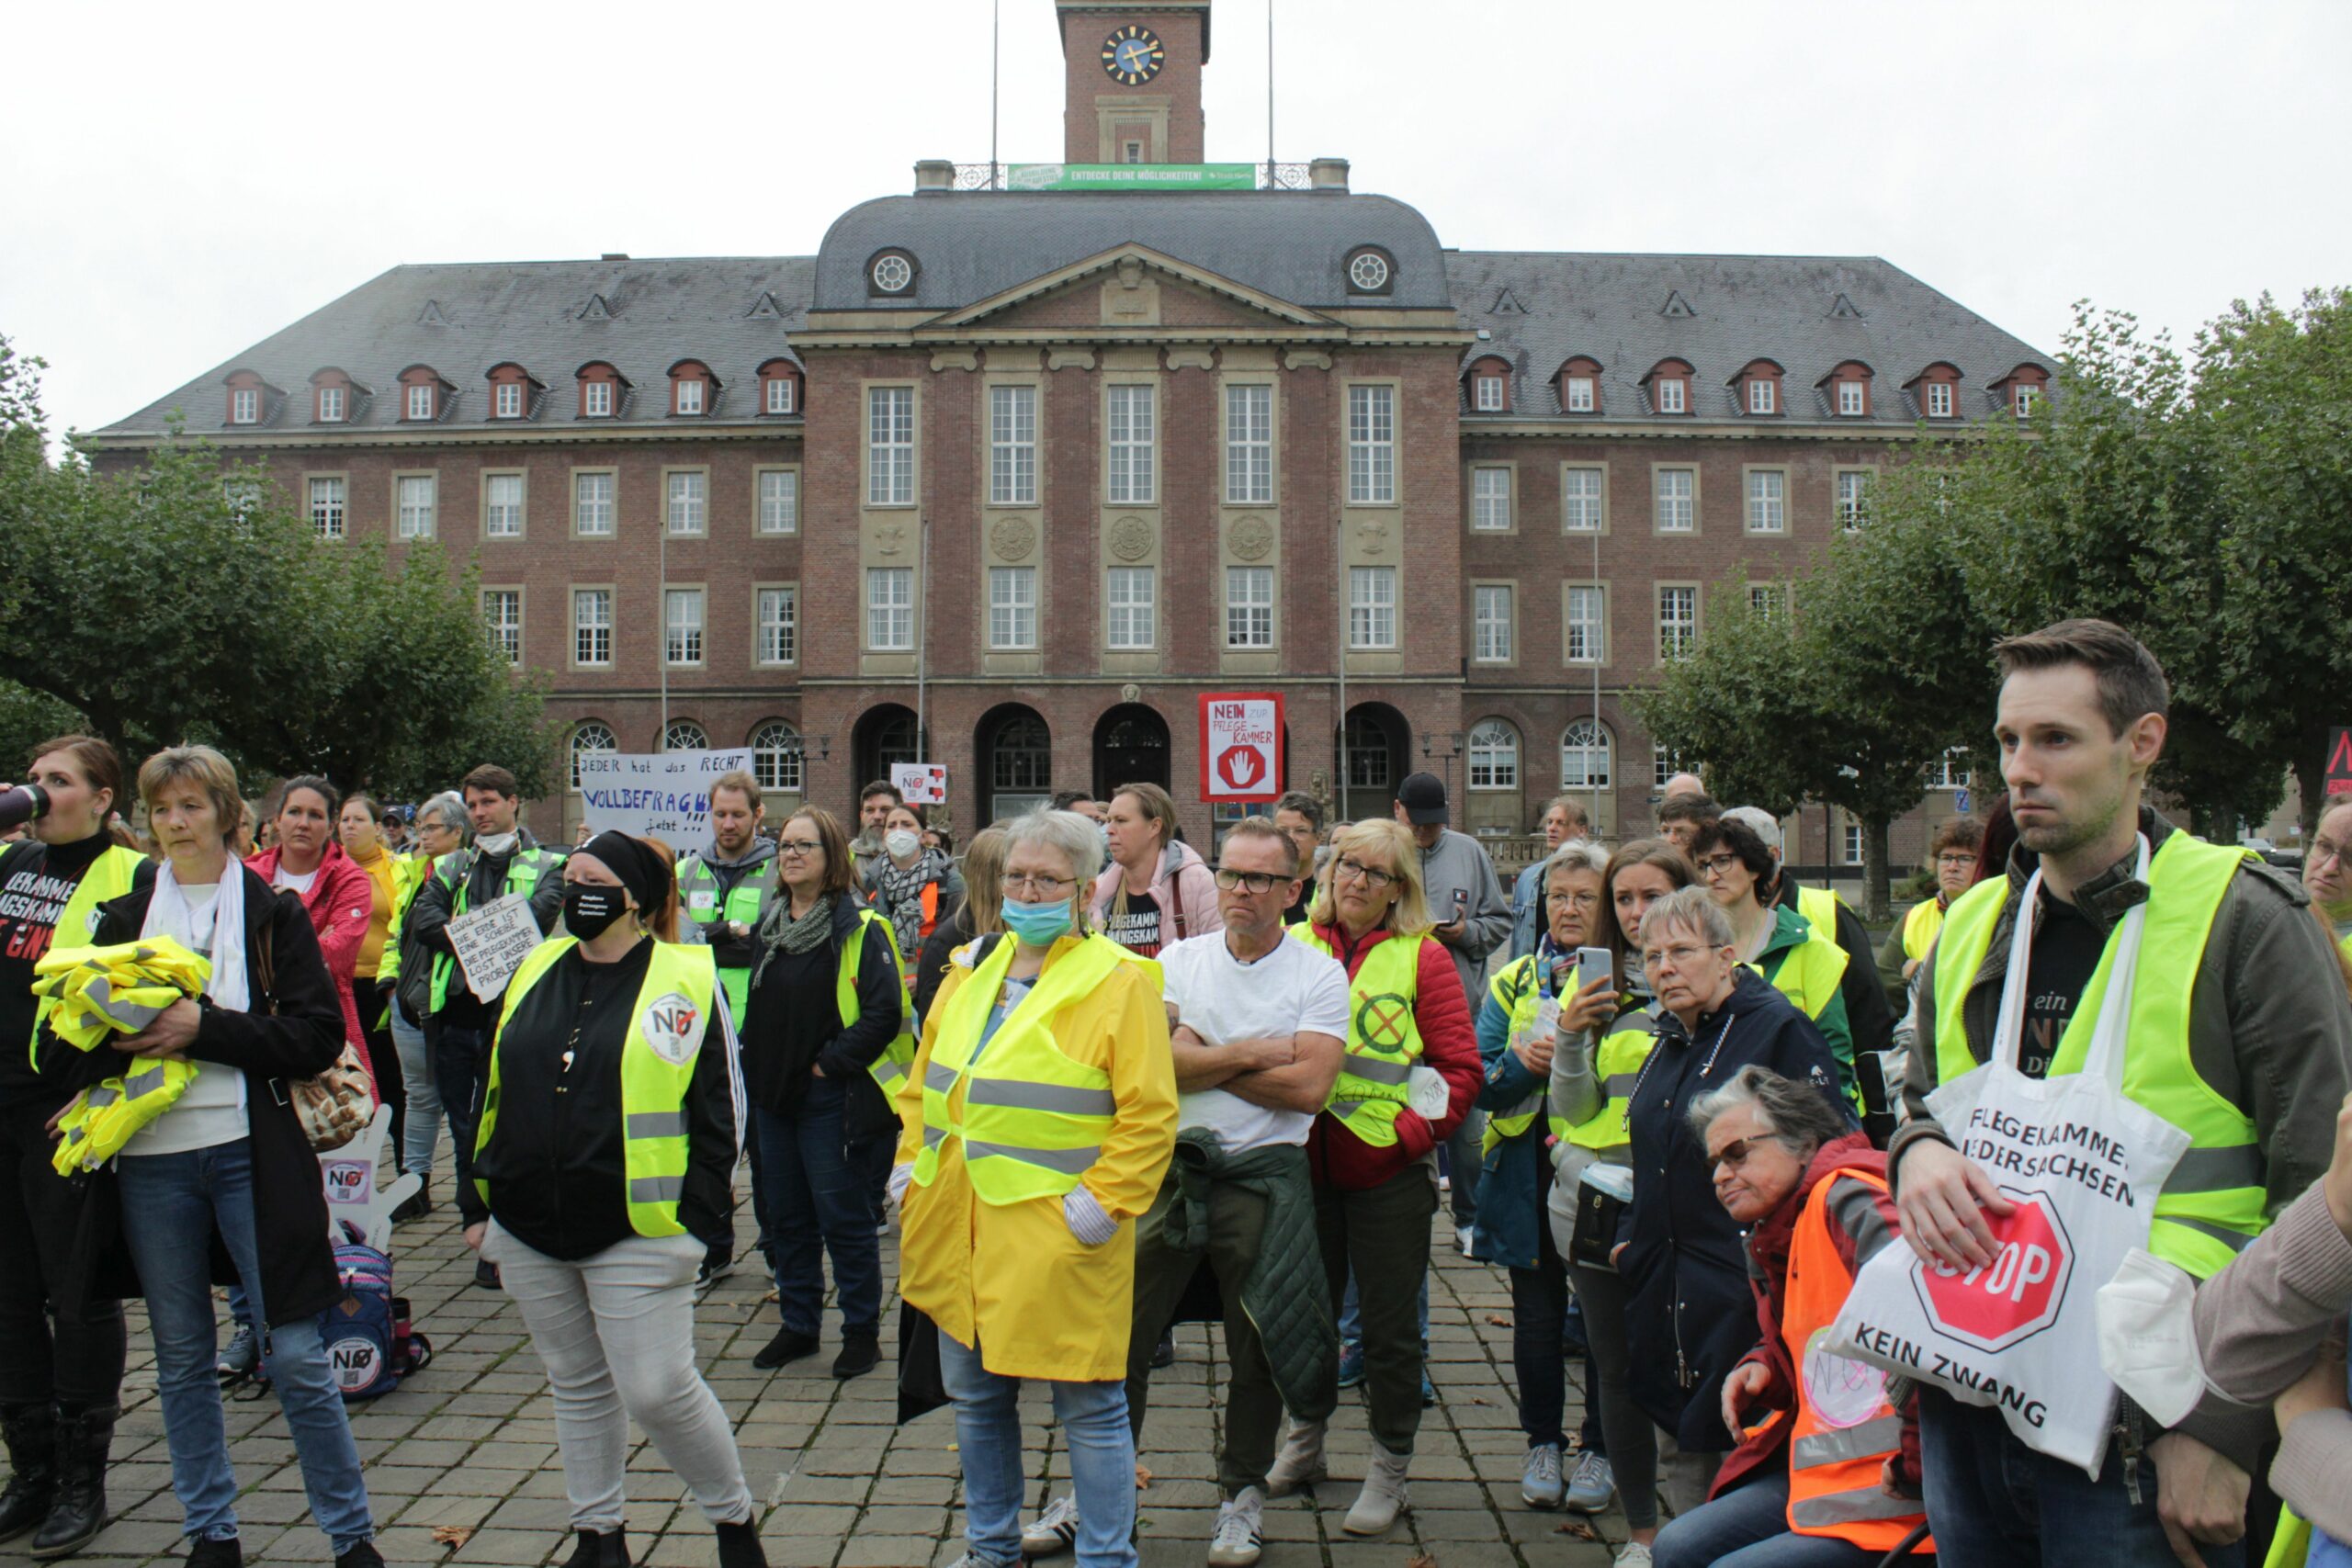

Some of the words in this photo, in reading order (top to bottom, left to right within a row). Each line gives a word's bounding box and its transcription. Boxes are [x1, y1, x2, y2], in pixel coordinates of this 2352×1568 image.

[1070, 171, 1111, 181] ENTDECKE
[1113, 171, 1136, 181] DEINE
[1137, 169, 1202, 181] MÖGLICHKEITEN!
[1214, 704, 1245, 719] NEIN
[1233, 731, 1272, 744] KAMMER
[581, 759, 621, 773] JEDER
[631, 760, 652, 773] hat
[665, 762, 686, 773] das
[700, 755, 745, 773] RECHT
[582, 788, 712, 813] VOLLBEFRAGU
[645, 818, 677, 835] jetzt
[454, 931, 471, 946] DIE
[474, 919, 498, 936] ERDE
[502, 907, 519, 922] IST
[458, 939, 480, 955] EINE
[500, 937, 534, 961] UNSERE
[464, 953, 479, 967] DIE
[2034, 990, 2067, 1010] ein
[329, 1169, 364, 1187] NO
[333, 1348, 373, 1370] NO
[1854, 1322, 1922, 1368] KEIN
[1931, 1352, 2048, 1428] ZWANG
